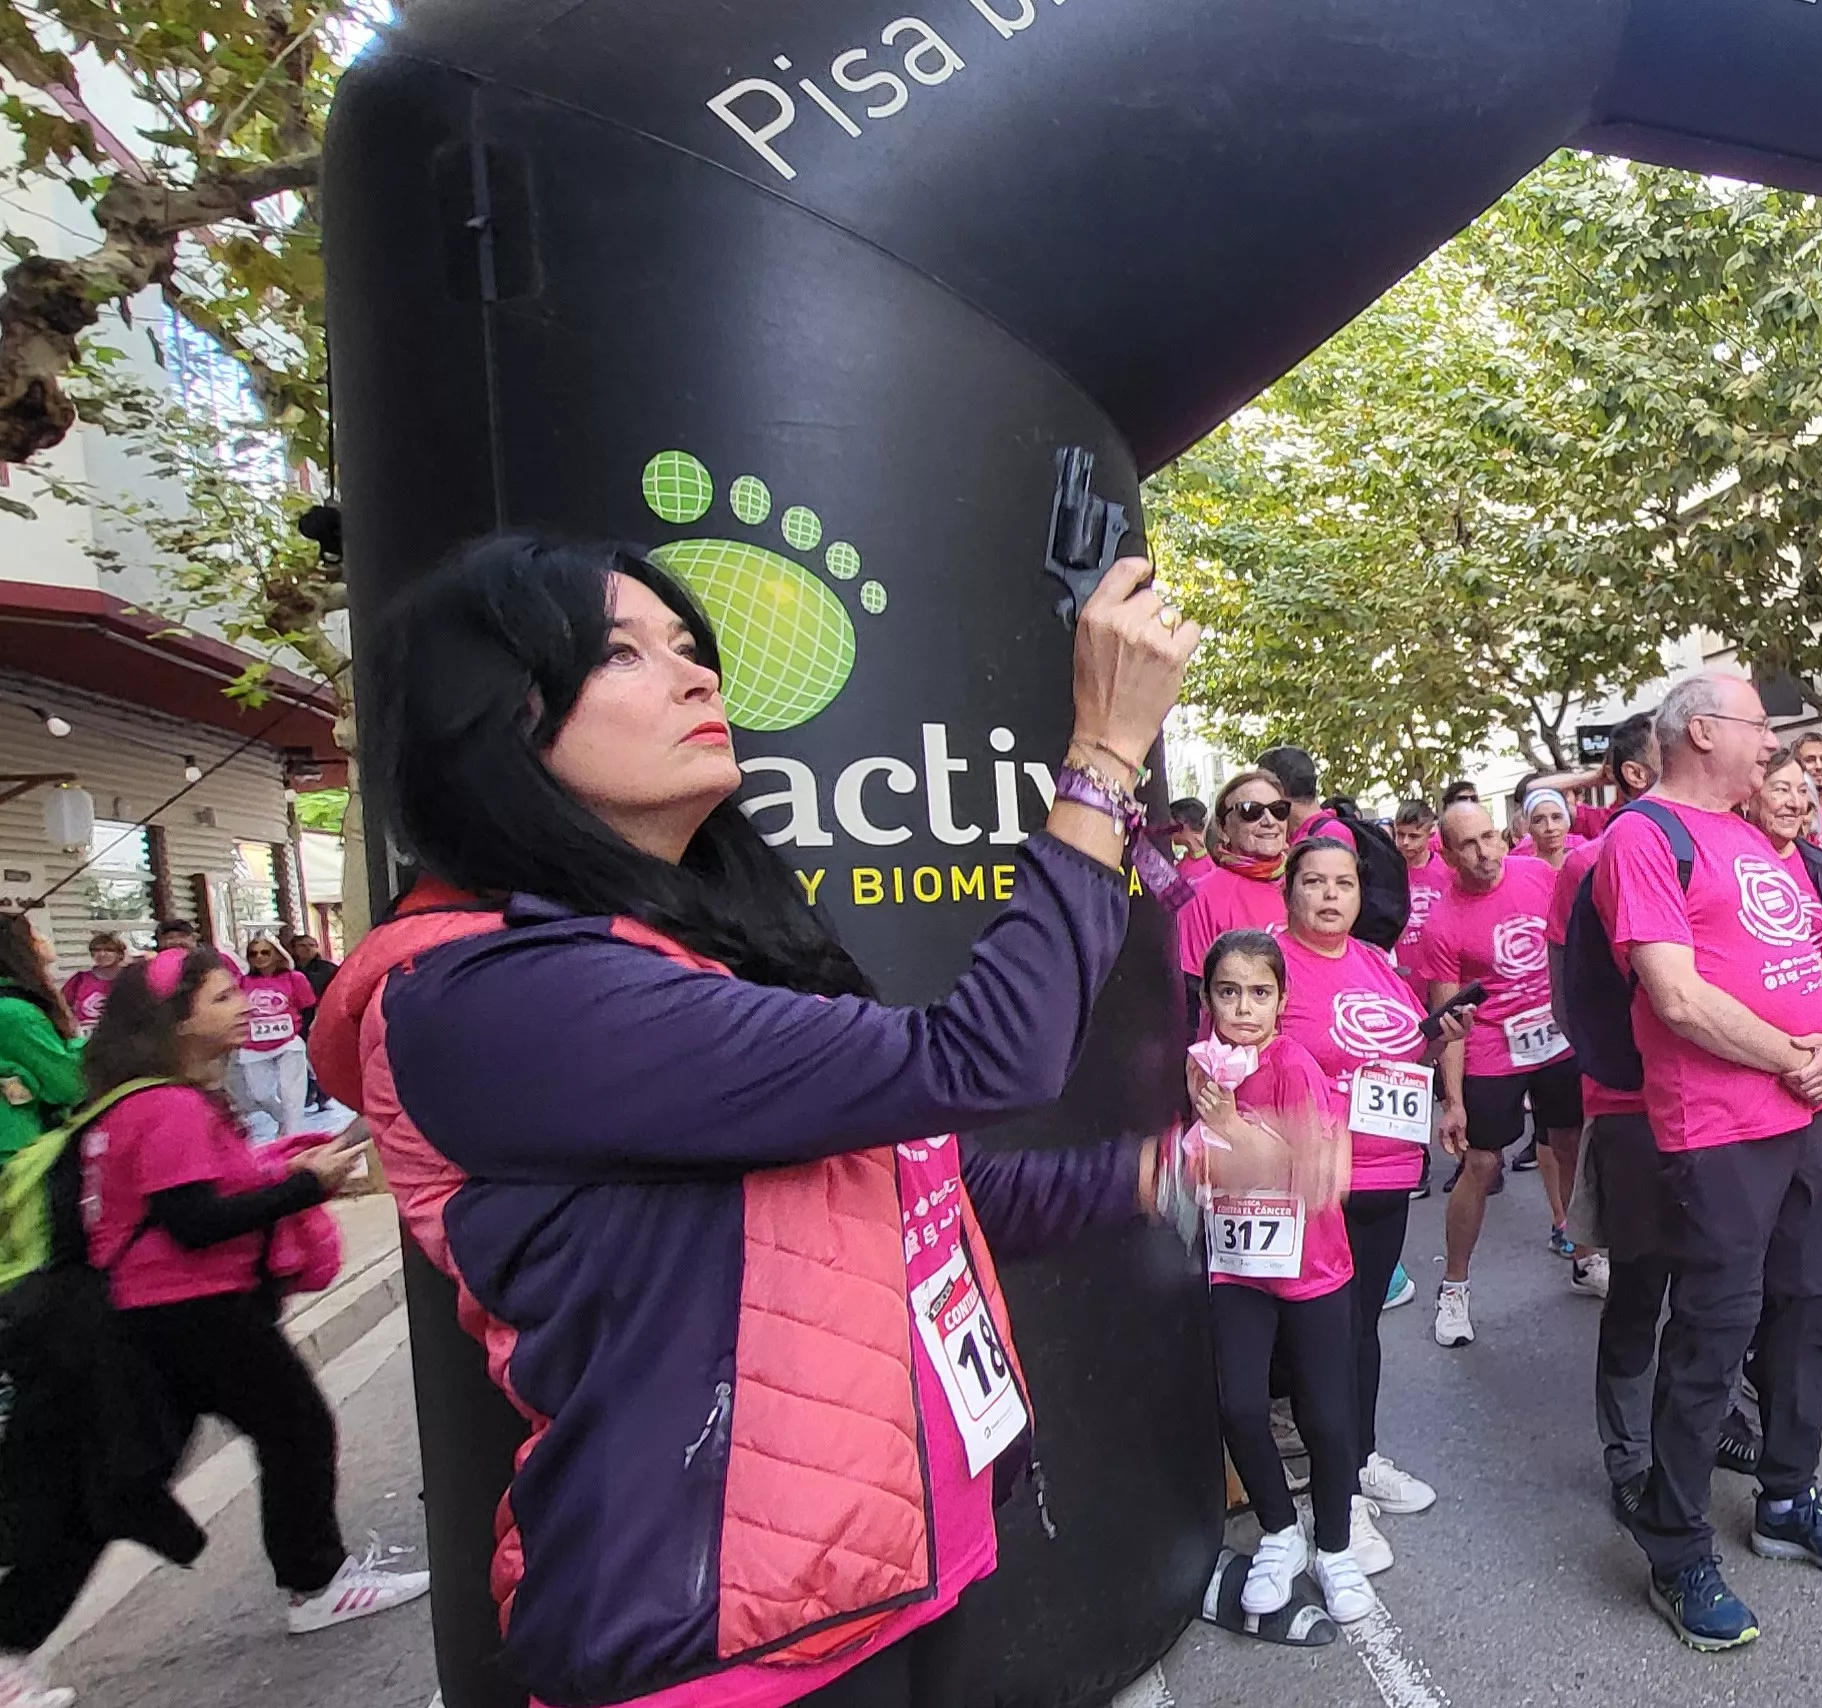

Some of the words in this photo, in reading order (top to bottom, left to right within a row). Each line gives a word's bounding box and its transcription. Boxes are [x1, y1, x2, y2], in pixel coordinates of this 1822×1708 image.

[705, 15, 966, 180] Pisa
[796, 869, 826, 907] Y
[1368, 1085, 1419, 1117] 316
[1223, 1219, 1281, 1251] 317
